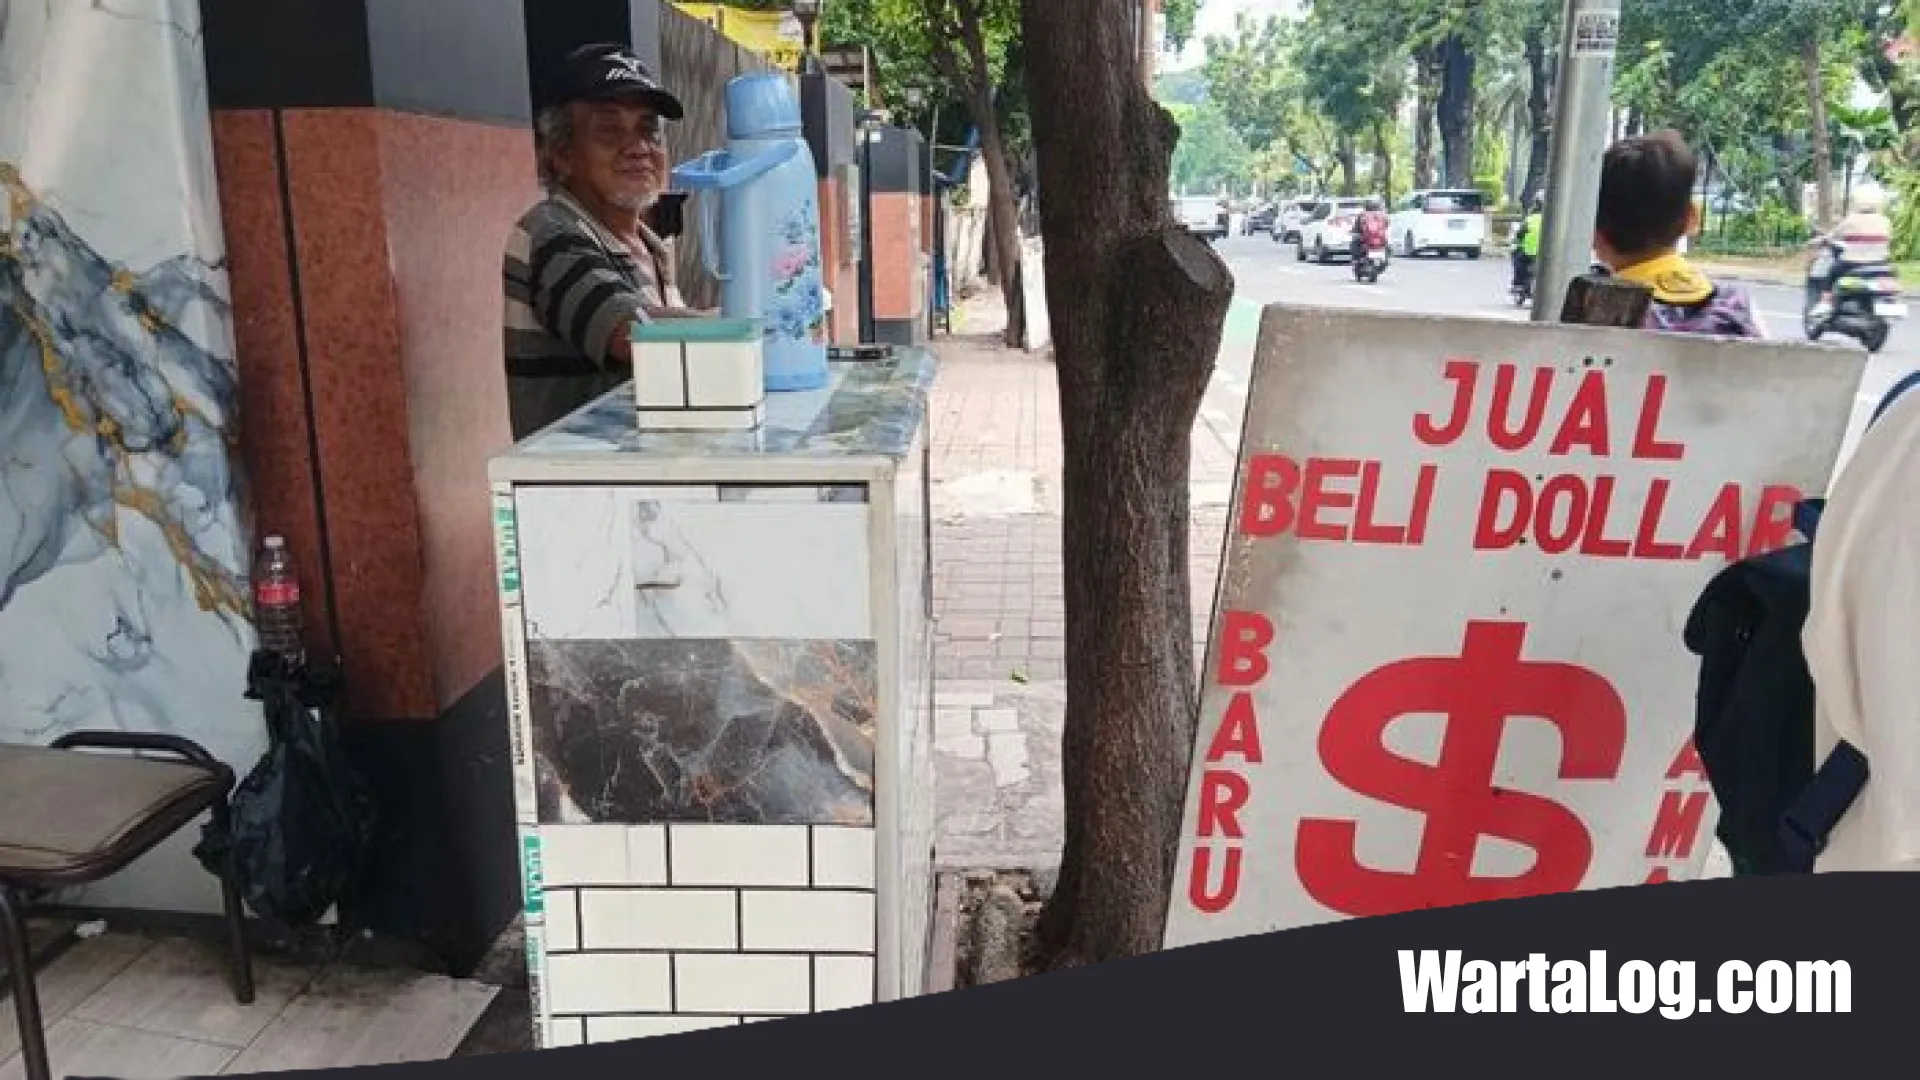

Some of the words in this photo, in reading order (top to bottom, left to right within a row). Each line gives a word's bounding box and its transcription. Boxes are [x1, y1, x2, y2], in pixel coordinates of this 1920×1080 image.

[1238, 453, 1437, 547] BELI
[1474, 468, 1803, 562] DOLLAR
[1411, 359, 1686, 462] JUAL
[1187, 609, 1275, 915] BARU
[1294, 619, 1628, 918] $
